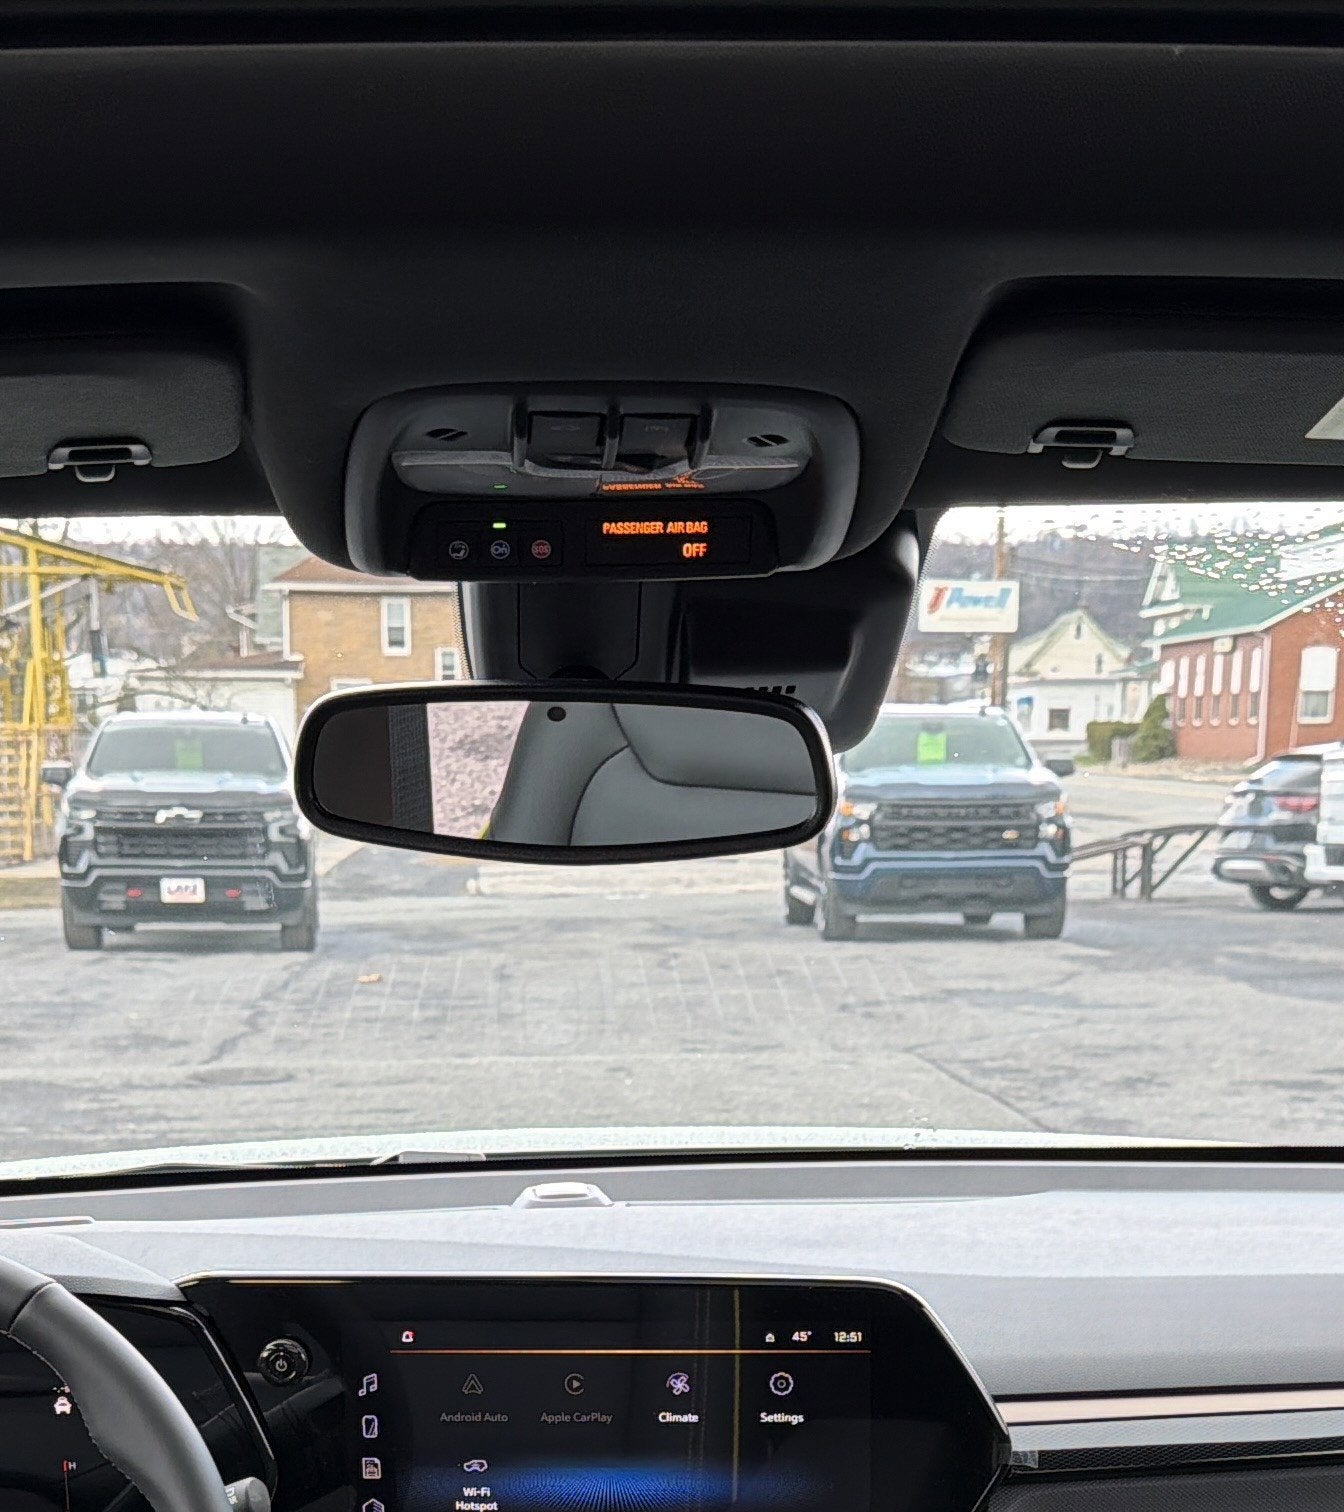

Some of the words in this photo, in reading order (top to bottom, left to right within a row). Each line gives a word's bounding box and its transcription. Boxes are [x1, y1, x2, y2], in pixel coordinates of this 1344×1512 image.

[602, 522, 664, 534] PASSENGER
[666, 521, 685, 534] AIR
[686, 521, 708, 534] BAG
[534, 545, 549, 554] SOS
[682, 543, 707, 558] OFF
[791, 1331, 812, 1342] 45°
[834, 1331, 862, 1343] 12:51
[440, 1412, 481, 1422] Android
[484, 1412, 508, 1422] Auto
[540, 1412, 571, 1424] Apple
[573, 1412, 613, 1424] CarPlay
[658, 1412, 699, 1423] Climate
[760, 1412, 804, 1425] Settings
[68, 1461, 76, 1470] H
[462, 1487, 491, 1497] Wi-Fi
[455, 1501, 498, 1512] Hotspot
